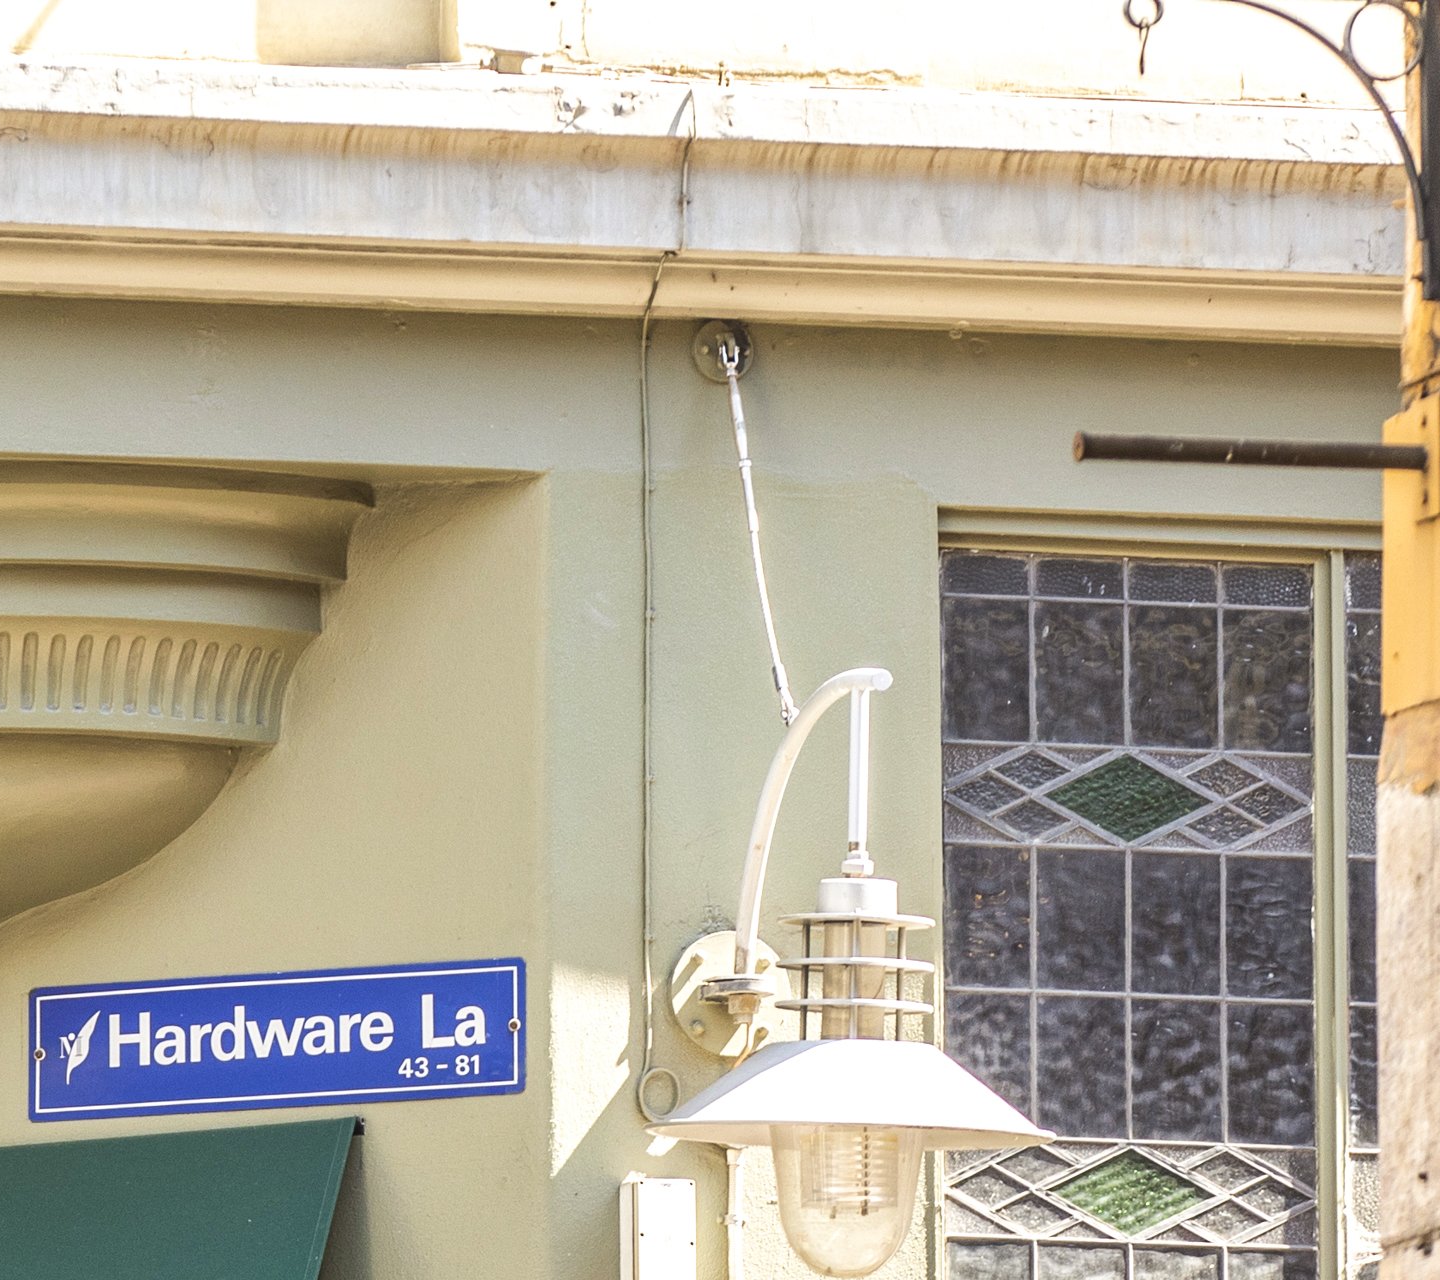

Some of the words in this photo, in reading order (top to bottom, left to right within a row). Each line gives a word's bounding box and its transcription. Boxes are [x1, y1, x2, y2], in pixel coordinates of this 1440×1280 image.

[108, 1005, 394, 1068] Hardware
[420, 993, 486, 1049] La
[398, 1057, 429, 1079] 43
[455, 1054, 481, 1077] 81
